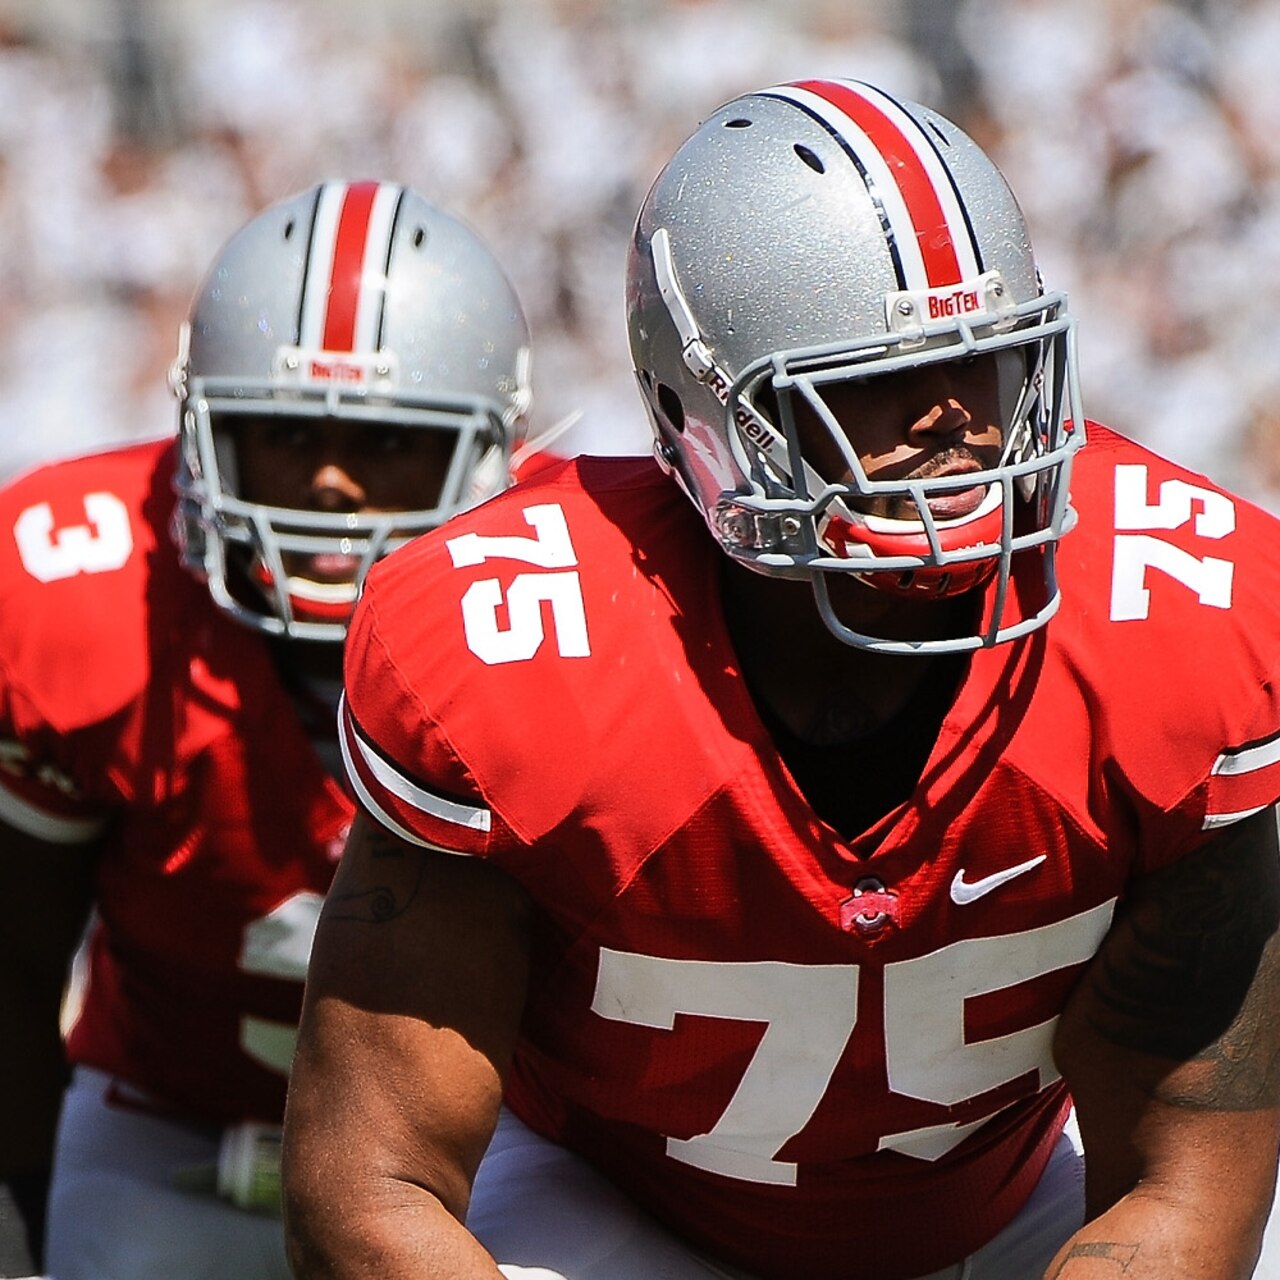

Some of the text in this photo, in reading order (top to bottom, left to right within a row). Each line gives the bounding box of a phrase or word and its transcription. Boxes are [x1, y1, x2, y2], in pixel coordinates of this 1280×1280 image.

[709, 375, 776, 451] Ridell
[14, 493, 133, 582] 3
[446, 504, 591, 664] 75
[1110, 465, 1236, 621] 75
[591, 897, 1117, 1186] 75
